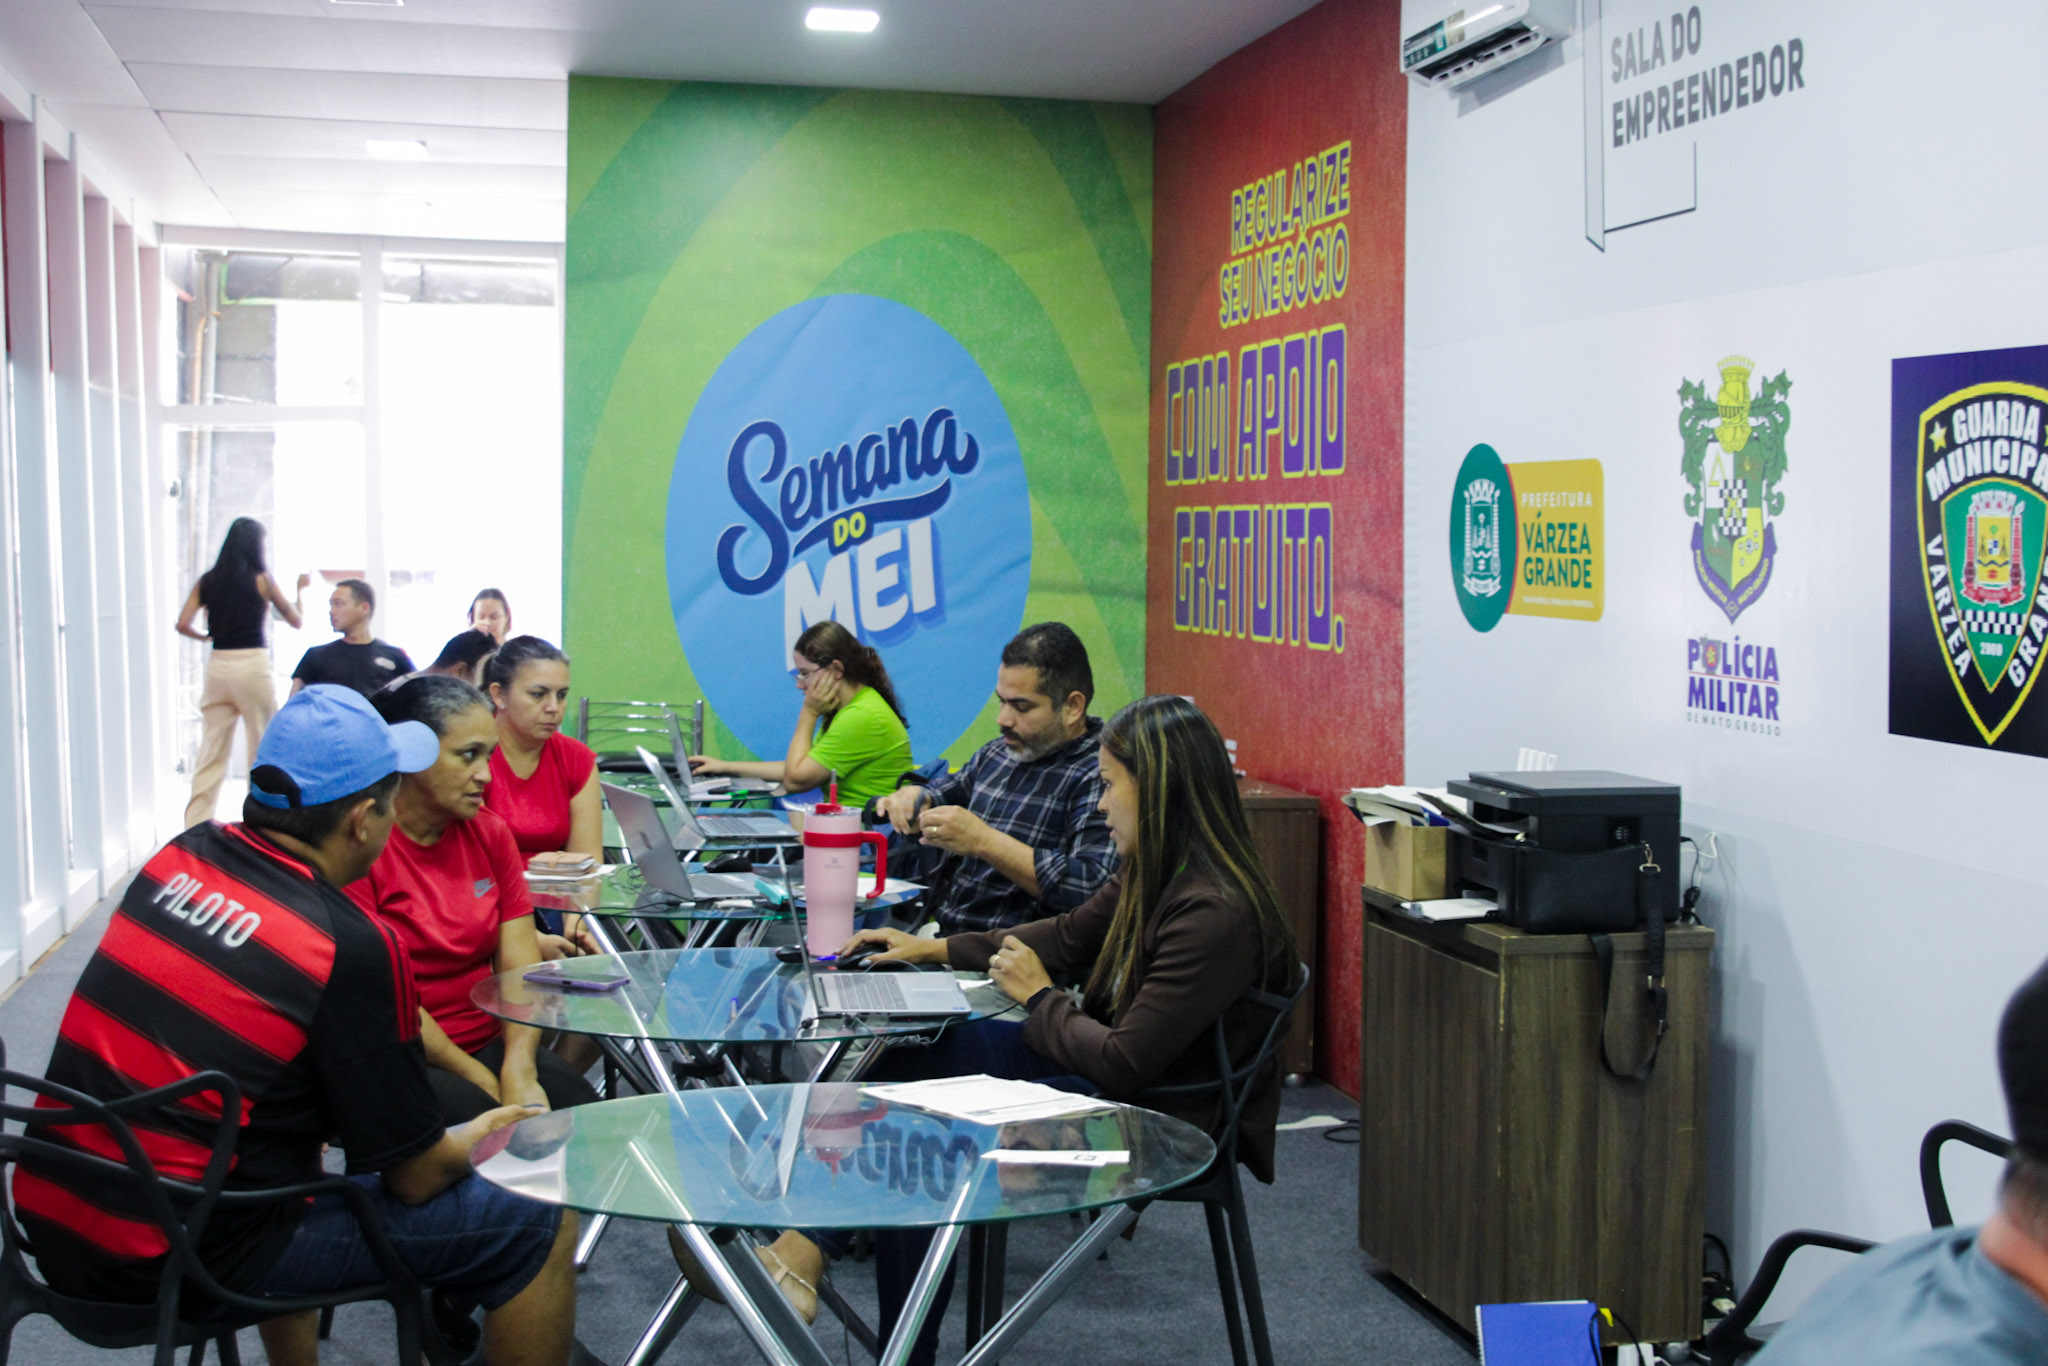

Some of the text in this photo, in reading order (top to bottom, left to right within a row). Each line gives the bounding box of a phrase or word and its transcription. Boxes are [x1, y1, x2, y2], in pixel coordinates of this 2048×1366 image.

[1611, 5, 1701, 84] SALA DO
[1613, 37, 1805, 148] EMPREENDEDOR
[1231, 140, 1351, 256] REGULARIZE
[1219, 222, 1349, 329] SEU NEGÓCIO
[1165, 323, 1347, 486] COM APOIO
[1952, 400, 2041, 445] GUARDA
[717, 407, 979, 595] Semana
[834, 511, 866, 547] DO
[1521, 491, 1593, 508] PREFEITURA
[1523, 510, 1592, 555] VÁRZEA
[784, 517, 940, 672] MEI
[1174, 502, 1345, 654] GRATUITO.
[1523, 556, 1593, 590] GRANDE
[1927, 533, 1972, 677] VARZEA
[1688, 634, 1779, 682] POLÍCIA
[1688, 676, 1780, 721] MILITAR
[153, 872, 262, 948] PILOTO
